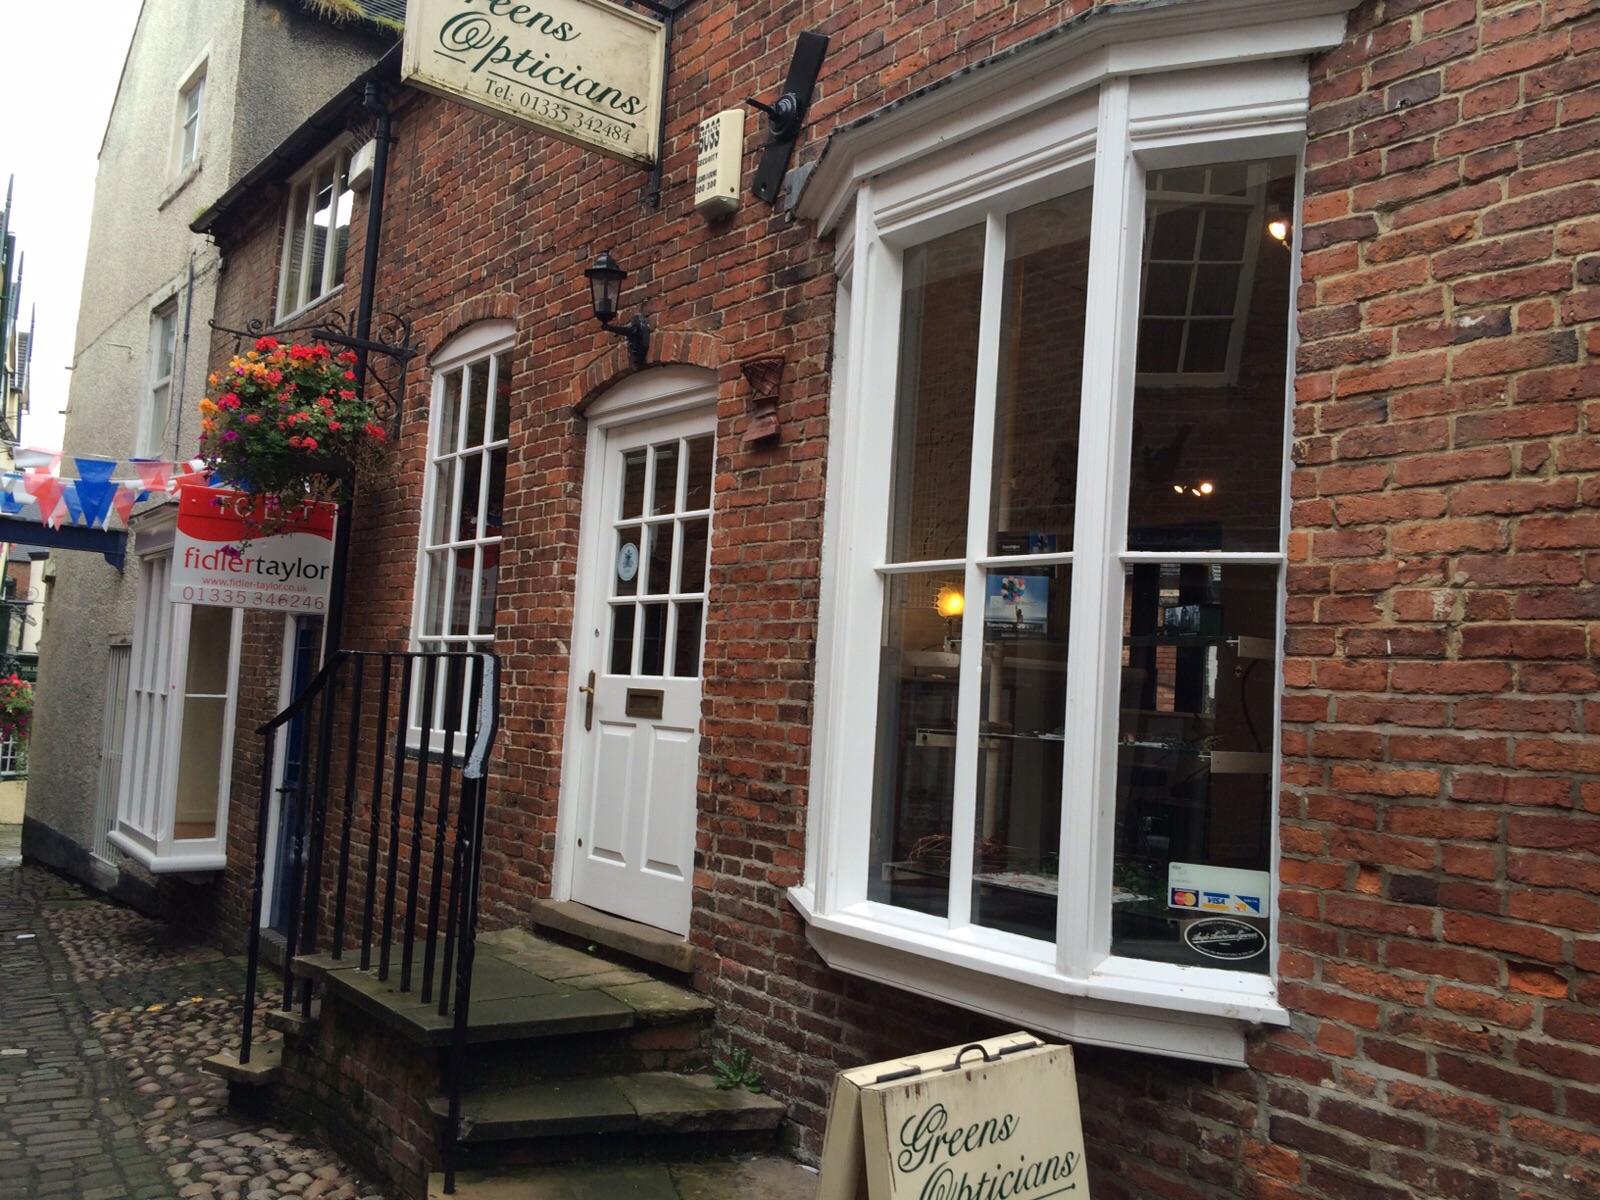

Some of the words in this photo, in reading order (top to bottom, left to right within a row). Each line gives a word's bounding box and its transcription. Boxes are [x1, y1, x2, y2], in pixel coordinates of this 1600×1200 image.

[464, 0, 581, 42] eens
[439, 11, 648, 115] Opticians
[485, 78, 514, 103] Tel:
[519, 92, 569, 123] 01335
[571, 111, 631, 144] 342484
[184, 547, 330, 582] fidlertaylor
[182, 586, 247, 604] 01335
[253, 591, 325, 610] 346246
[202, 577, 308, 593] www.fidler-taylor.co.uk
[1207, 896, 1226, 905] VISA
[898, 1103, 1020, 1173] Greens
